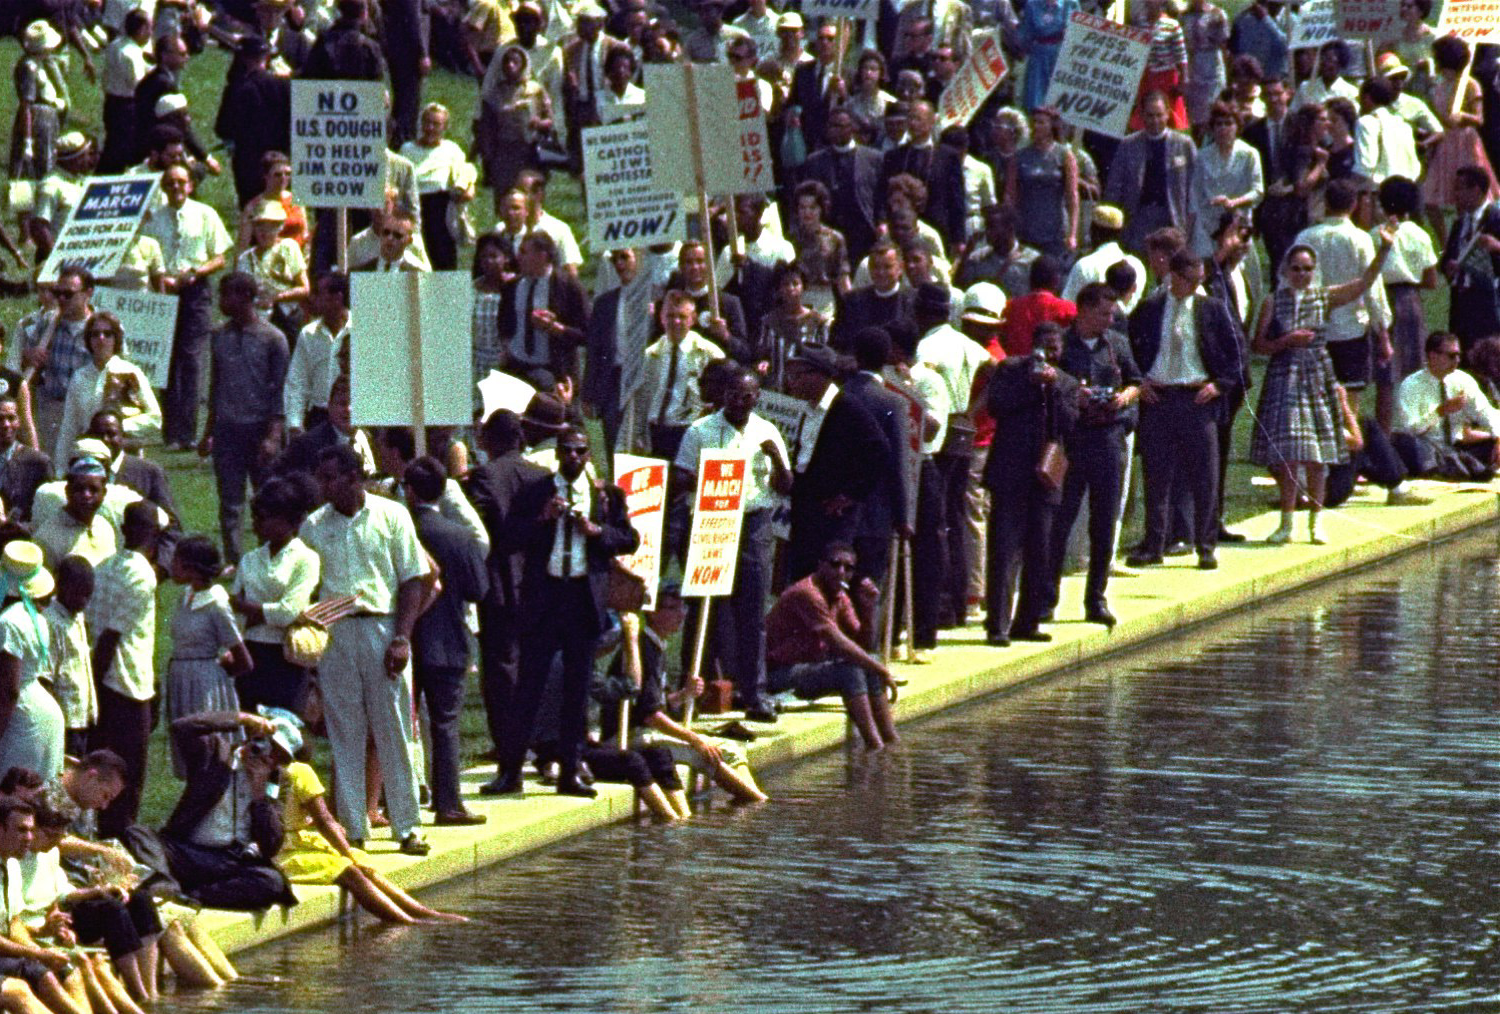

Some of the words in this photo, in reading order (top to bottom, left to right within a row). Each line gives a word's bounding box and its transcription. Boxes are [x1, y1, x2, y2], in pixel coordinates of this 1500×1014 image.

[317, 91, 359, 112] NO
[1054, 92, 1120, 120] NOW
[326, 119, 383, 138] DOUGH
[305, 144, 327, 159] TO
[331, 144, 373, 159] HELP
[596, 144, 651, 161] CATHOL
[296, 161, 327, 177] JIM
[331, 161, 380, 177] CROW
[594, 168, 653, 185] PROTESTA
[311, 181, 366, 197] GROW
[83, 193, 144, 211] MARCH
[603, 210, 678, 241] NOW!
[702, 479, 742, 497] MARCH
